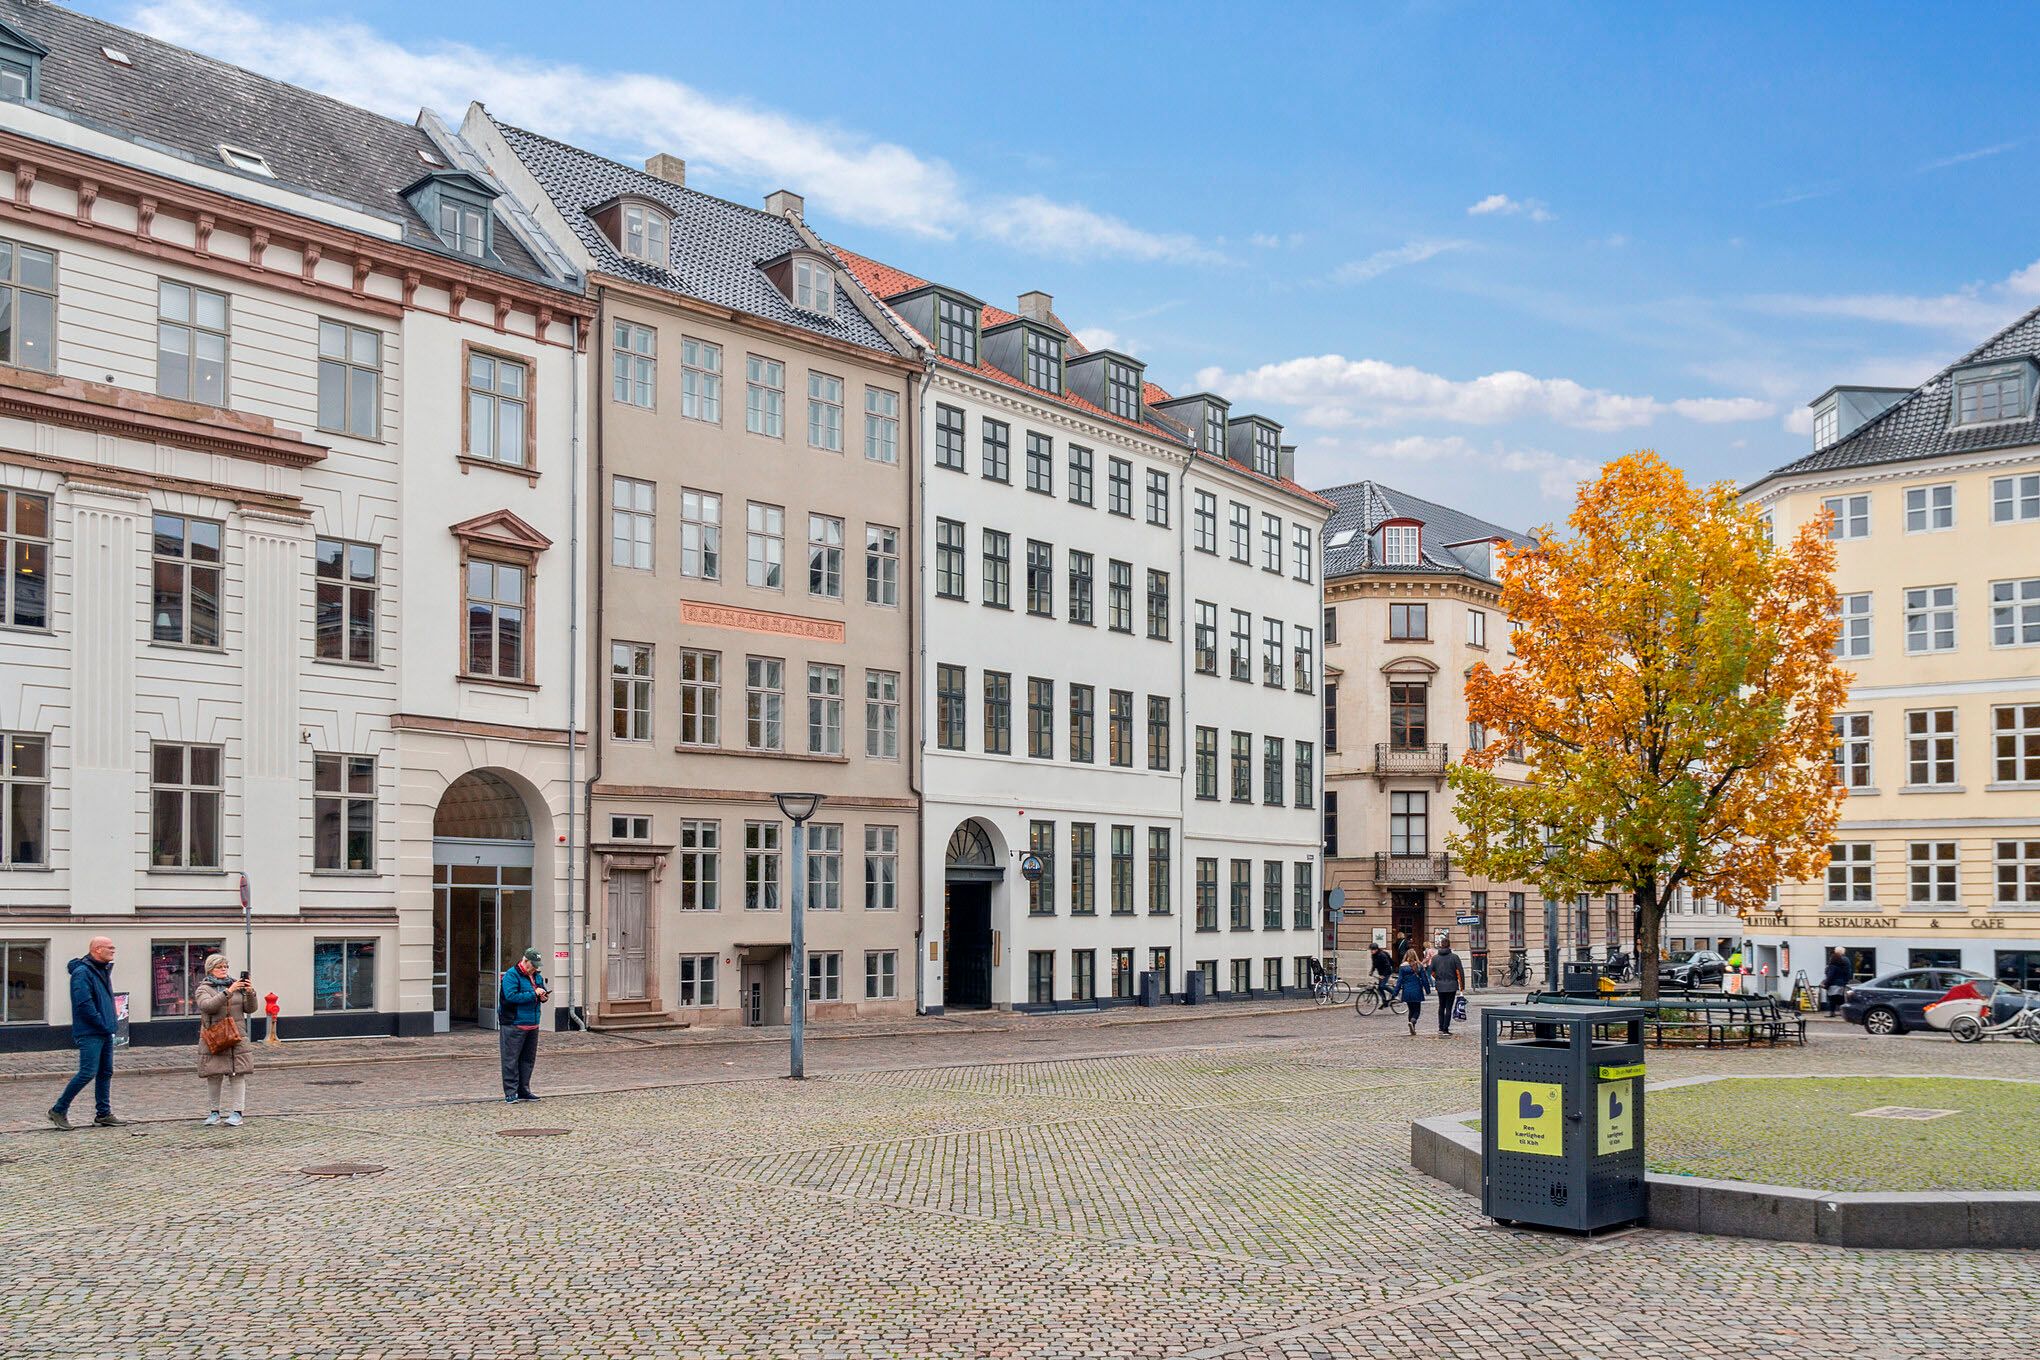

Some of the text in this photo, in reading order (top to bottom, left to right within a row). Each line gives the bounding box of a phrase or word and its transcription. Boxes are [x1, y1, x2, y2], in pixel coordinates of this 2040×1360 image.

[475, 856, 480, 864] 7
[1818, 917, 2004, 929] RESTAURANT & CAFE
[1515, 1131, 1545, 1140] kærlighed
